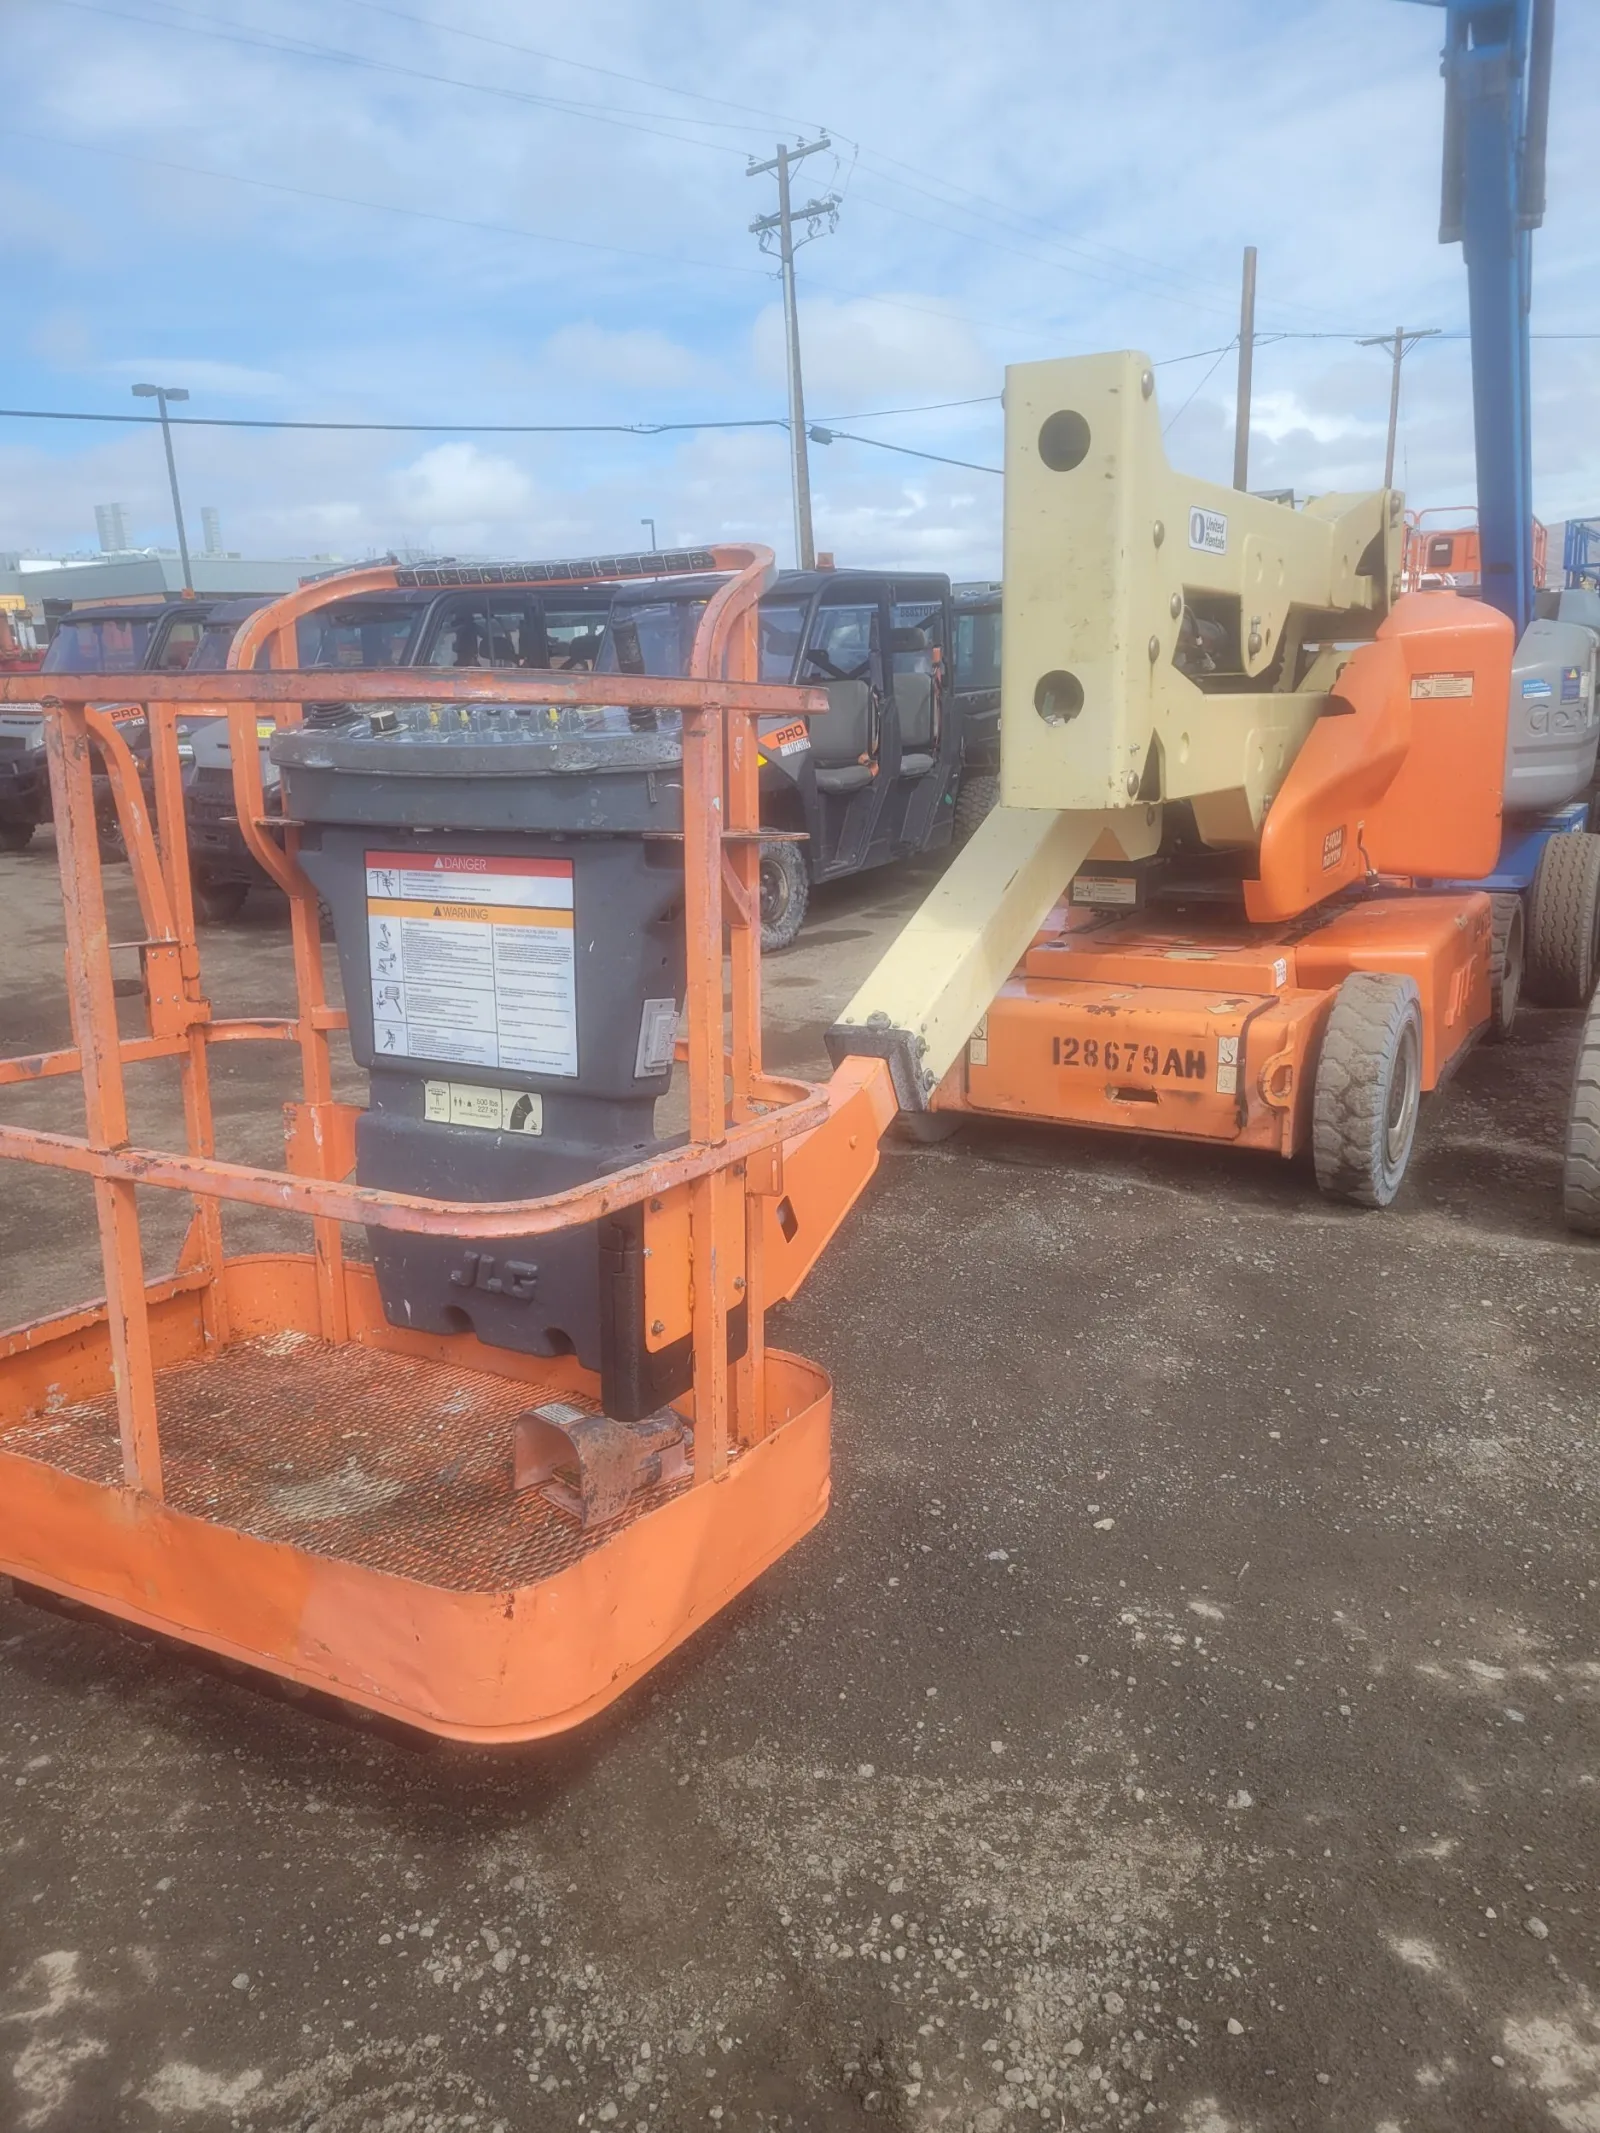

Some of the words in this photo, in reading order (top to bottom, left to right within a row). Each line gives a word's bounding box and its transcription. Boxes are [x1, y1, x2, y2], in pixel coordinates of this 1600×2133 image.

[1205, 516, 1226, 534] United
[1204, 532, 1226, 550] Rentals
[110, 706, 142, 720] PRO
[131, 718, 145, 727] XD
[776, 724, 804, 745] PRO
[443, 857, 487, 871] DANGER
[442, 906, 489, 920] WARNING
[1052, 1036, 1207, 1080] 128679AH
[476, 1098, 488, 1106] 500
[489, 1099, 499, 1107] lbs
[489, 1107, 498, 1116] kg
[448, 1249, 539, 1302] JLG
